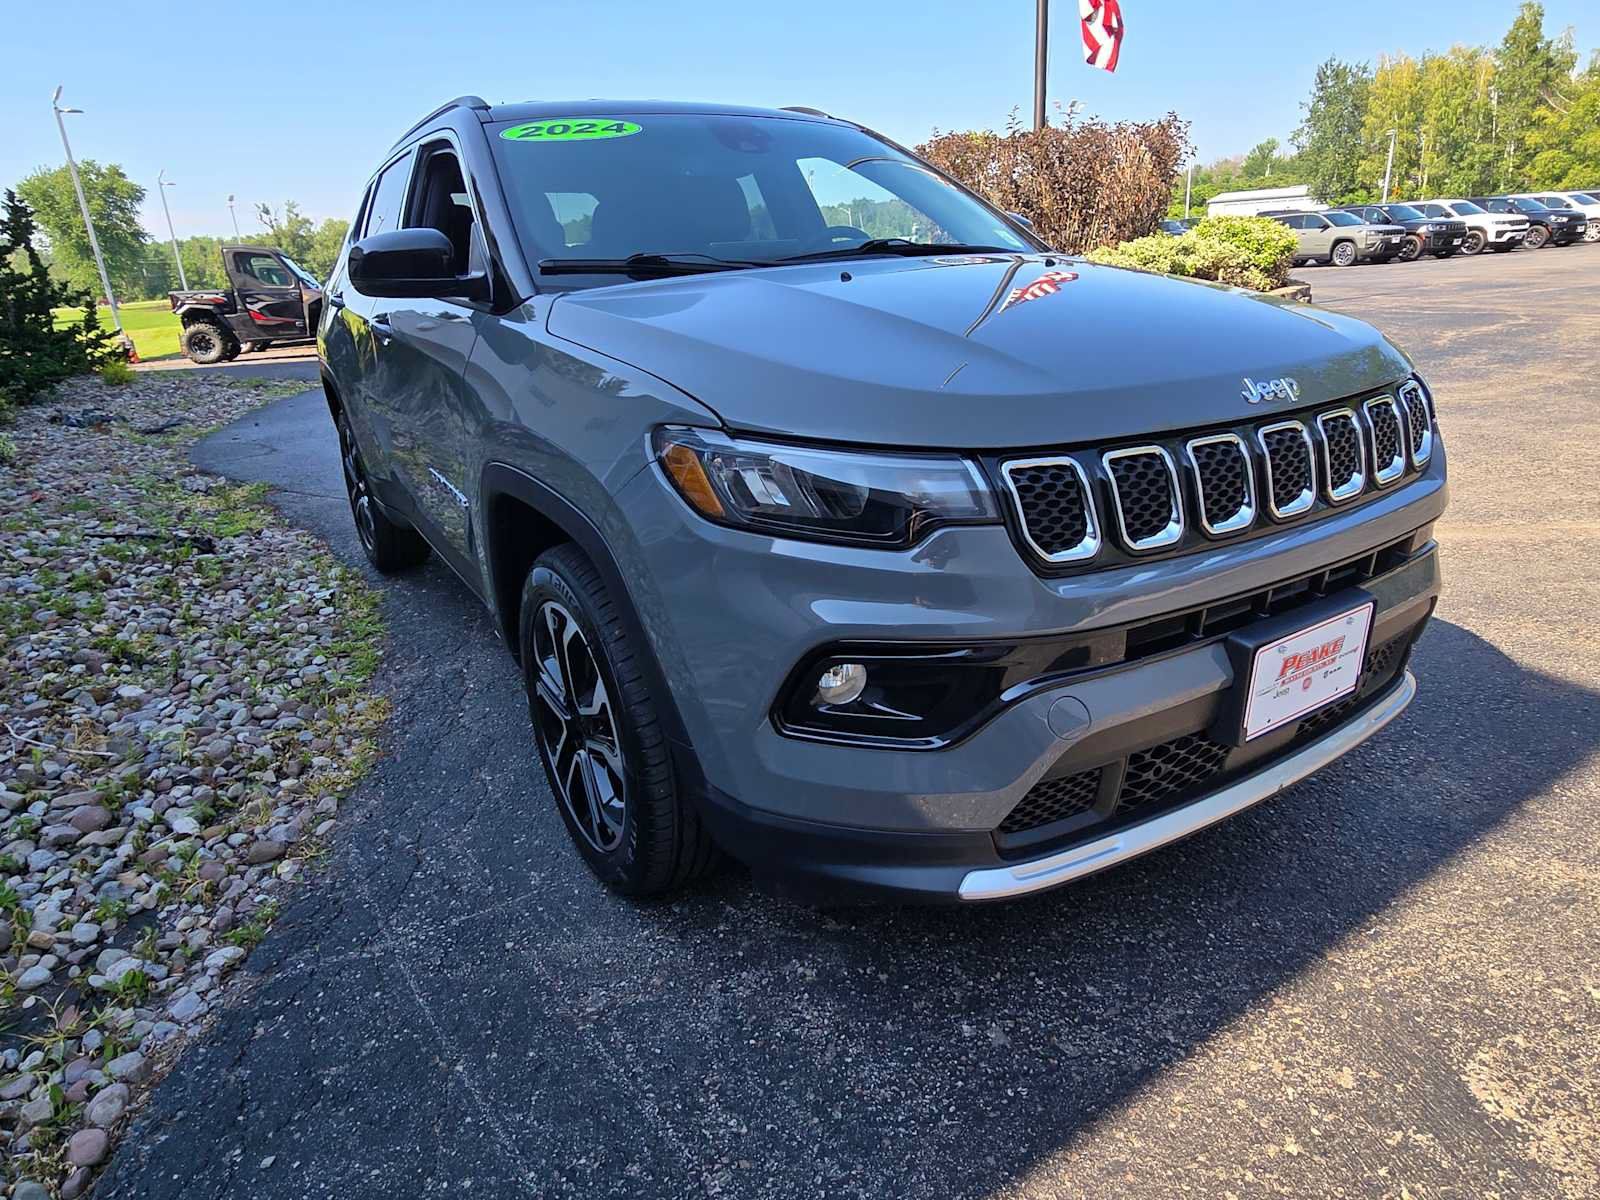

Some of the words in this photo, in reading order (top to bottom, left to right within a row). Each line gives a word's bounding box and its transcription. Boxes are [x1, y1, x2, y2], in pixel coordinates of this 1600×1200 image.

[516, 122, 628, 139] 2024
[1241, 377, 1300, 404] Jeep
[1279, 635, 1345, 677] PEAKE
